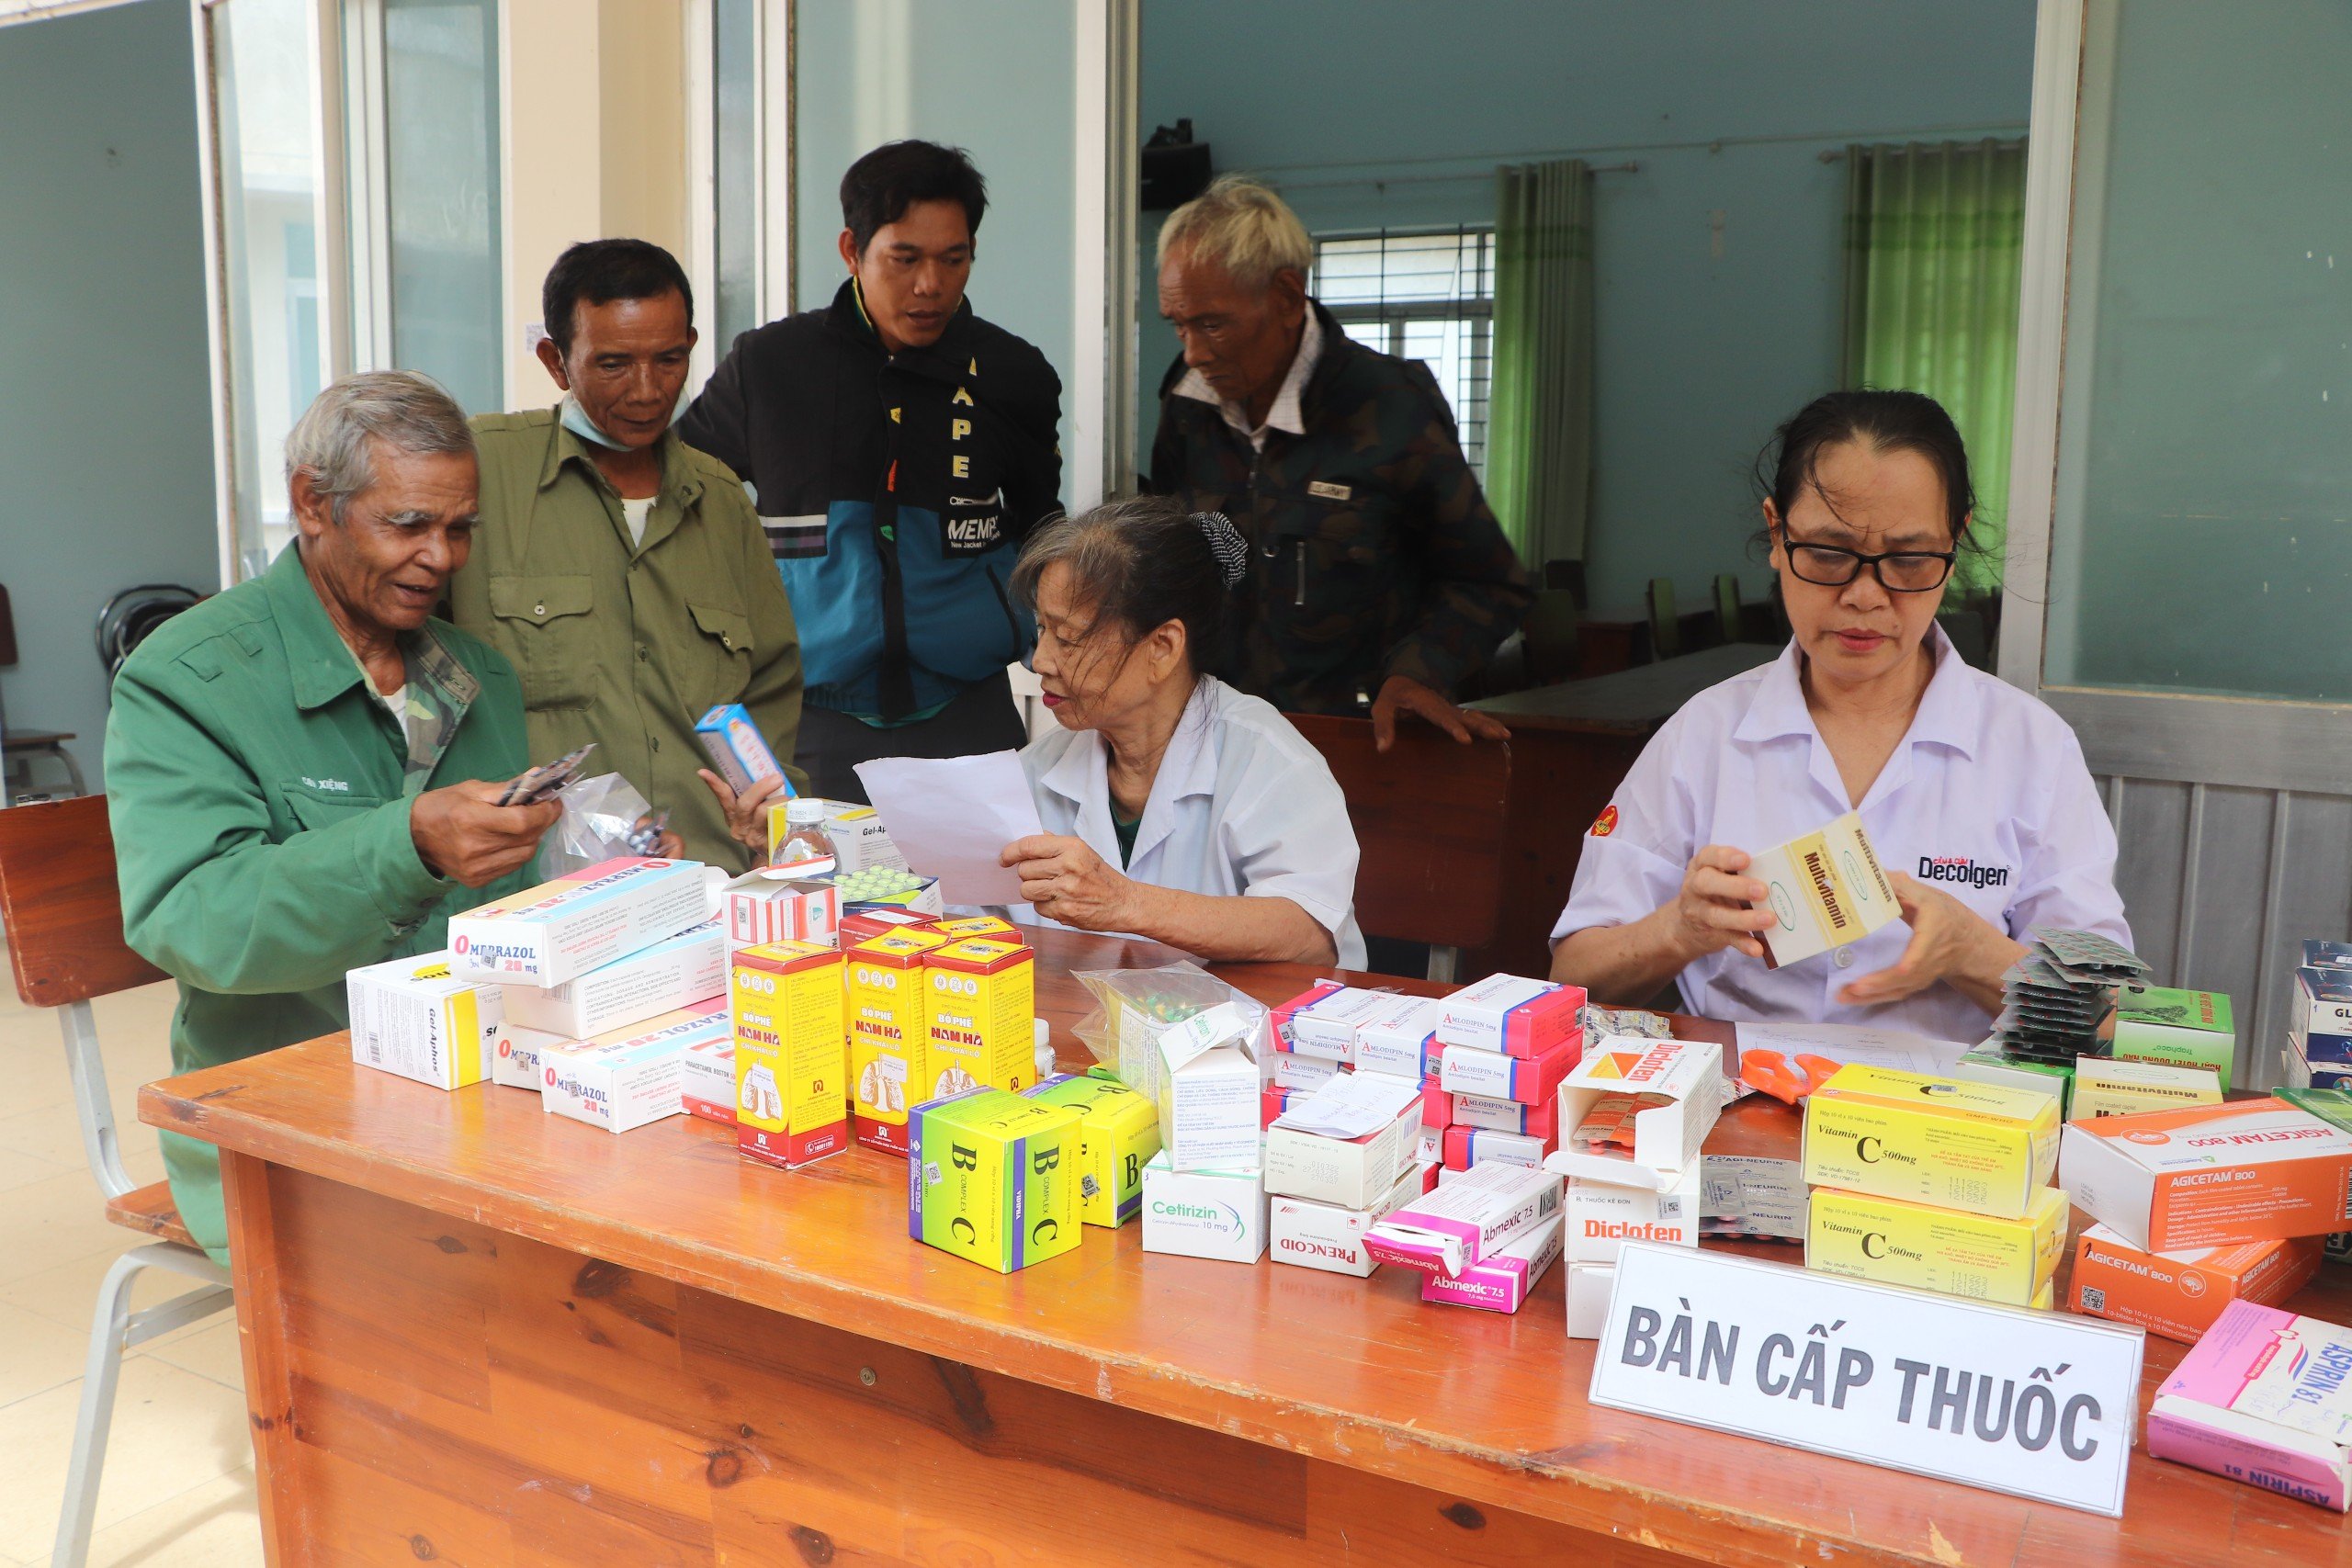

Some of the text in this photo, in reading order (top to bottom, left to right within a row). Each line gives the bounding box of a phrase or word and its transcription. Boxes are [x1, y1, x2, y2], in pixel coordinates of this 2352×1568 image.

[1918, 856, 2007, 889] Decolgen
[1804, 851, 1847, 929] Multivitamin
[505, 961, 537, 974] 20 mg
[856, 1021, 901, 1039] NAM HÀ
[1443, 1013, 1484, 1028] AMLODIPIN
[429, 1008, 439, 1073] Gel-Aphos
[739, 1025, 780, 1045] NAM HÀ
[932, 1027, 983, 1045] NAM HÀ
[1310, 1042, 1350, 1054] AMLODIPIN
[1362, 1042, 1403, 1055] AMLODIPIN
[2156, 1044, 2193, 1055] Traphaco
[685, 1060, 712, 1073] PARACETAMOL
[714, 1068, 729, 1077] BOSTON
[1282, 1060, 1320, 1073] AMLODIPIN
[1449, 1062, 1492, 1076] AMLODIPIN
[1627, 1043, 1684, 1082] Diclofen
[1062, 1085, 1131, 1115] B C
[1870, 1074, 1924, 1086] Vitamin
[1954, 1093, 2006, 1105] 500mg
[584, 1100, 609, 1118] 20 mg
[701, 1104, 711, 1113] 100
[1459, 1097, 1516, 1113] AMLODIPIN 5mg
[1966, 1113, 2014, 1123] GMP-WHO
[1818, 1124, 1917, 1165] Vitamin C 500mg
[2188, 1128, 2334, 1147] AGICETAM 800
[952, 1140, 977, 1172] B
[1035, 1143, 1059, 1175] B
[1125, 1153, 1139, 1190] B
[2171, 1170, 2256, 1187] AGICETAM 800
[1152, 1201, 1217, 1220] Cetirizin
[952, 1217, 976, 1246] C
[1033, 1219, 1057, 1246] C
[1214, 1224, 1227, 1233] mg
[1483, 1205, 1533, 1246] Abmexic 7.5
[1585, 1220, 1681, 1241] Diclofen
[1281, 1238, 1356, 1264] PRENCOID
[1822, 1220, 1922, 1262] Vitamin C 500mg
[1390, 1253, 1440, 1271] Abmexic
[1530, 1244, 1552, 1278] Abmexic
[2086, 1250, 2173, 1283] AGICETAM 800
[2242, 1258, 2269, 1286] AGICETAM
[1432, 1276, 1505, 1297] Abmexic 7.5
[2107, 1310, 2197, 1341] 10-blister box 10 film-coated
[2120, 1305, 2133, 1315] Hộp
[2163, 1317, 2176, 1325] viên
[2189, 1325, 2202, 1334] bao
[1621, 1297, 1740, 1385] BÀN
[1756, 1320, 1874, 1410] CẤP
[1894, 1363, 2102, 1462] THUỐC
[2300, 1343, 2352, 1394] ASPIRIN
[2250, 1471, 2331, 1505] ASPIRIN
